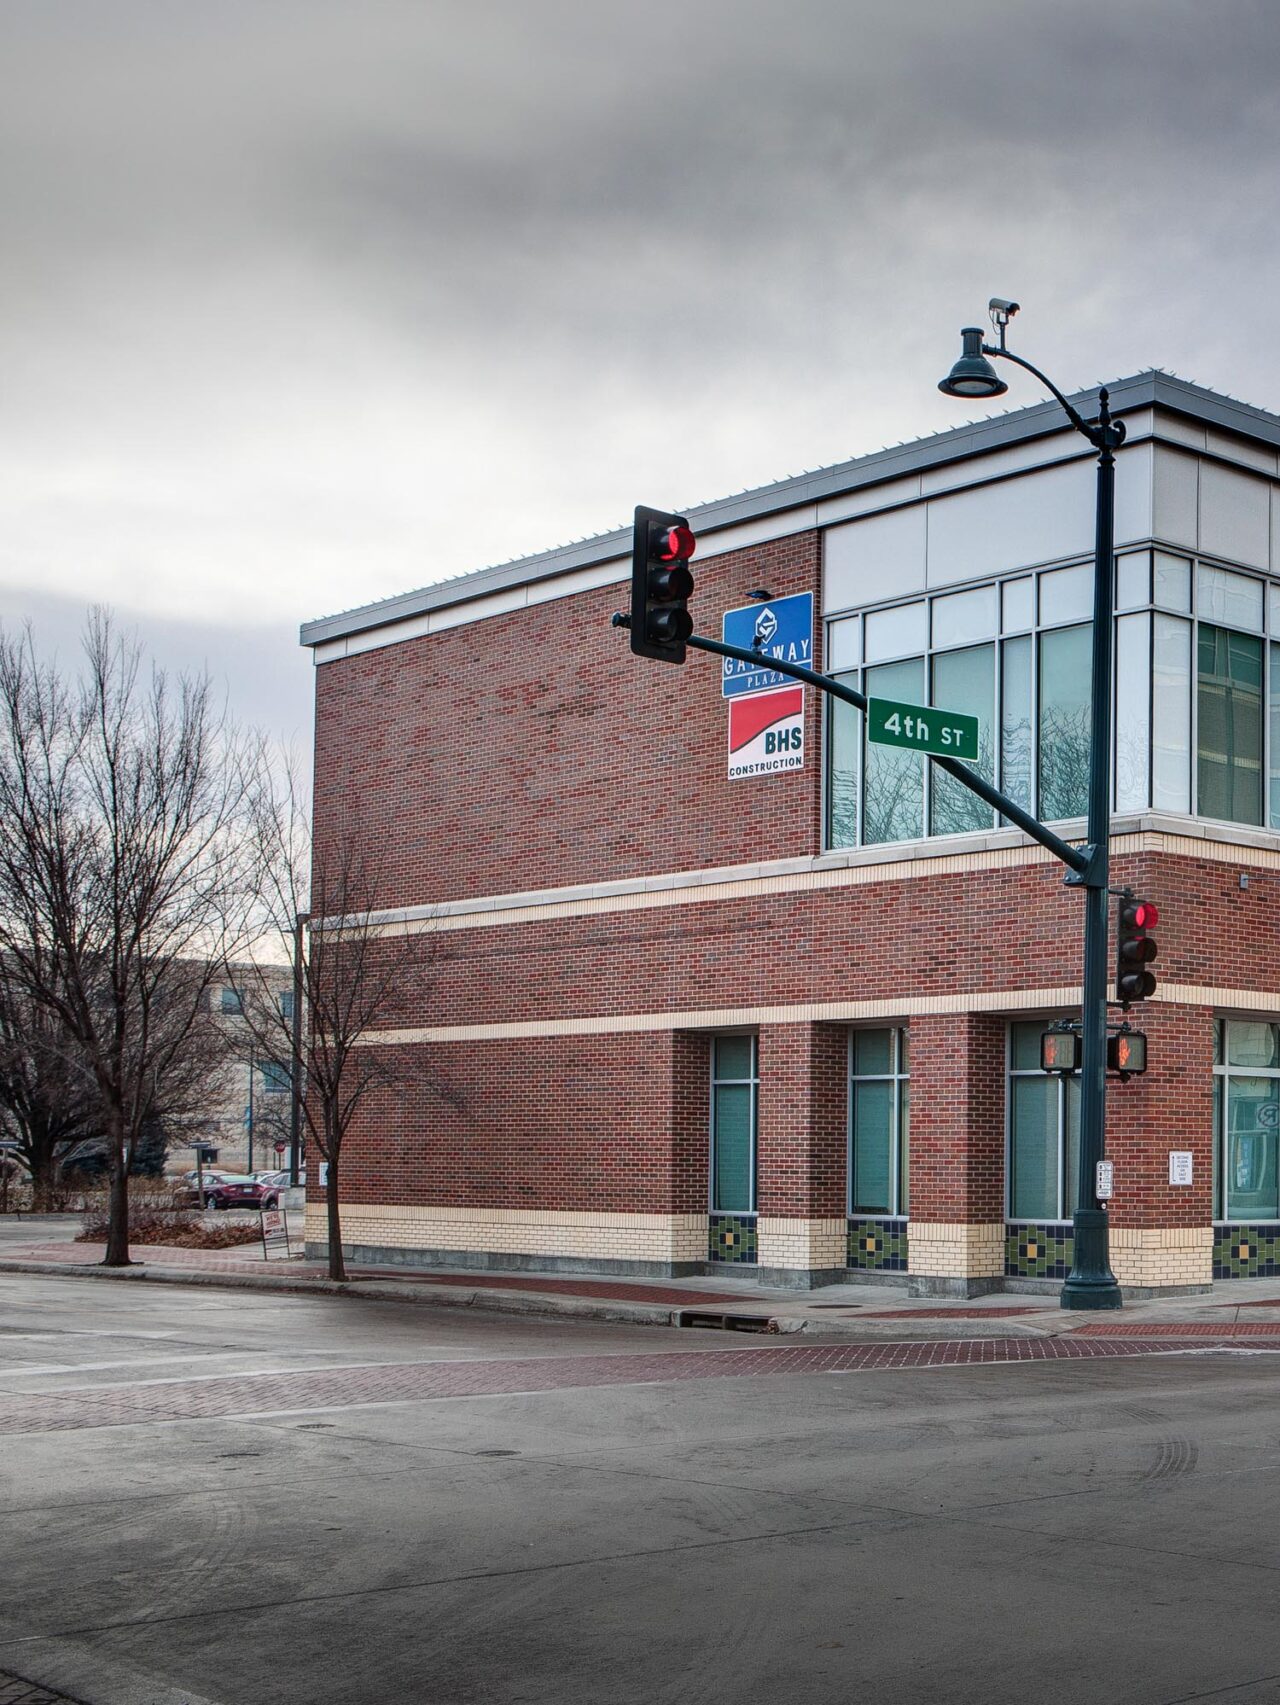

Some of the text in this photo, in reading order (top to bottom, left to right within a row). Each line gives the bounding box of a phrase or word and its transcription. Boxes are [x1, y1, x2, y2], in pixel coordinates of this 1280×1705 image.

[747, 671, 785, 688] PLAZA
[765, 727, 802, 755] BHS
[884, 712, 964, 747] 4th ST
[729, 756, 802, 777] CONSTRUCTION
